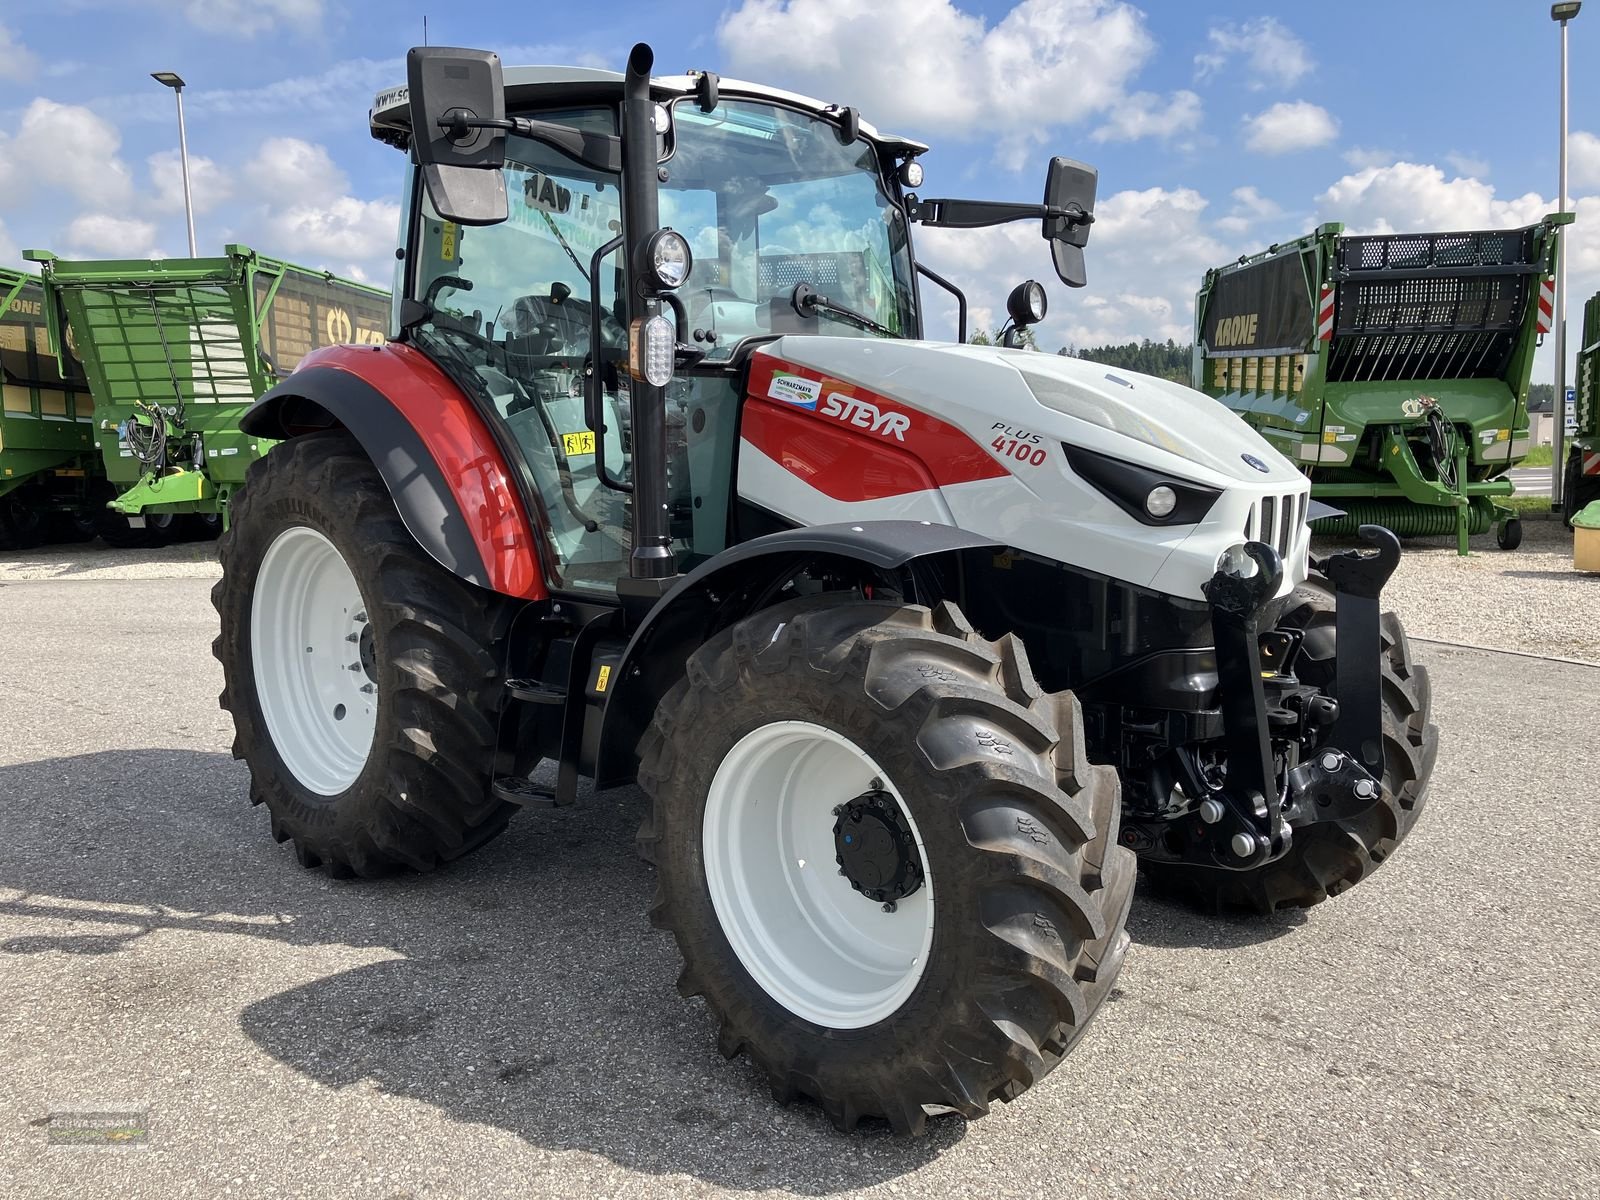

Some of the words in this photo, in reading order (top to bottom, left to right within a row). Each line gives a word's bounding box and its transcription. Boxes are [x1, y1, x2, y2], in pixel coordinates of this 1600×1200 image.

[375, 89, 409, 108] WWW.SC
[0, 296, 41, 315] ONE
[356, 327, 386, 345] KR
[1215, 314, 1258, 347] KRONE
[820, 392, 911, 442] STEYR
[991, 422, 1044, 444] PLUS
[991, 435, 1047, 467] 4100
